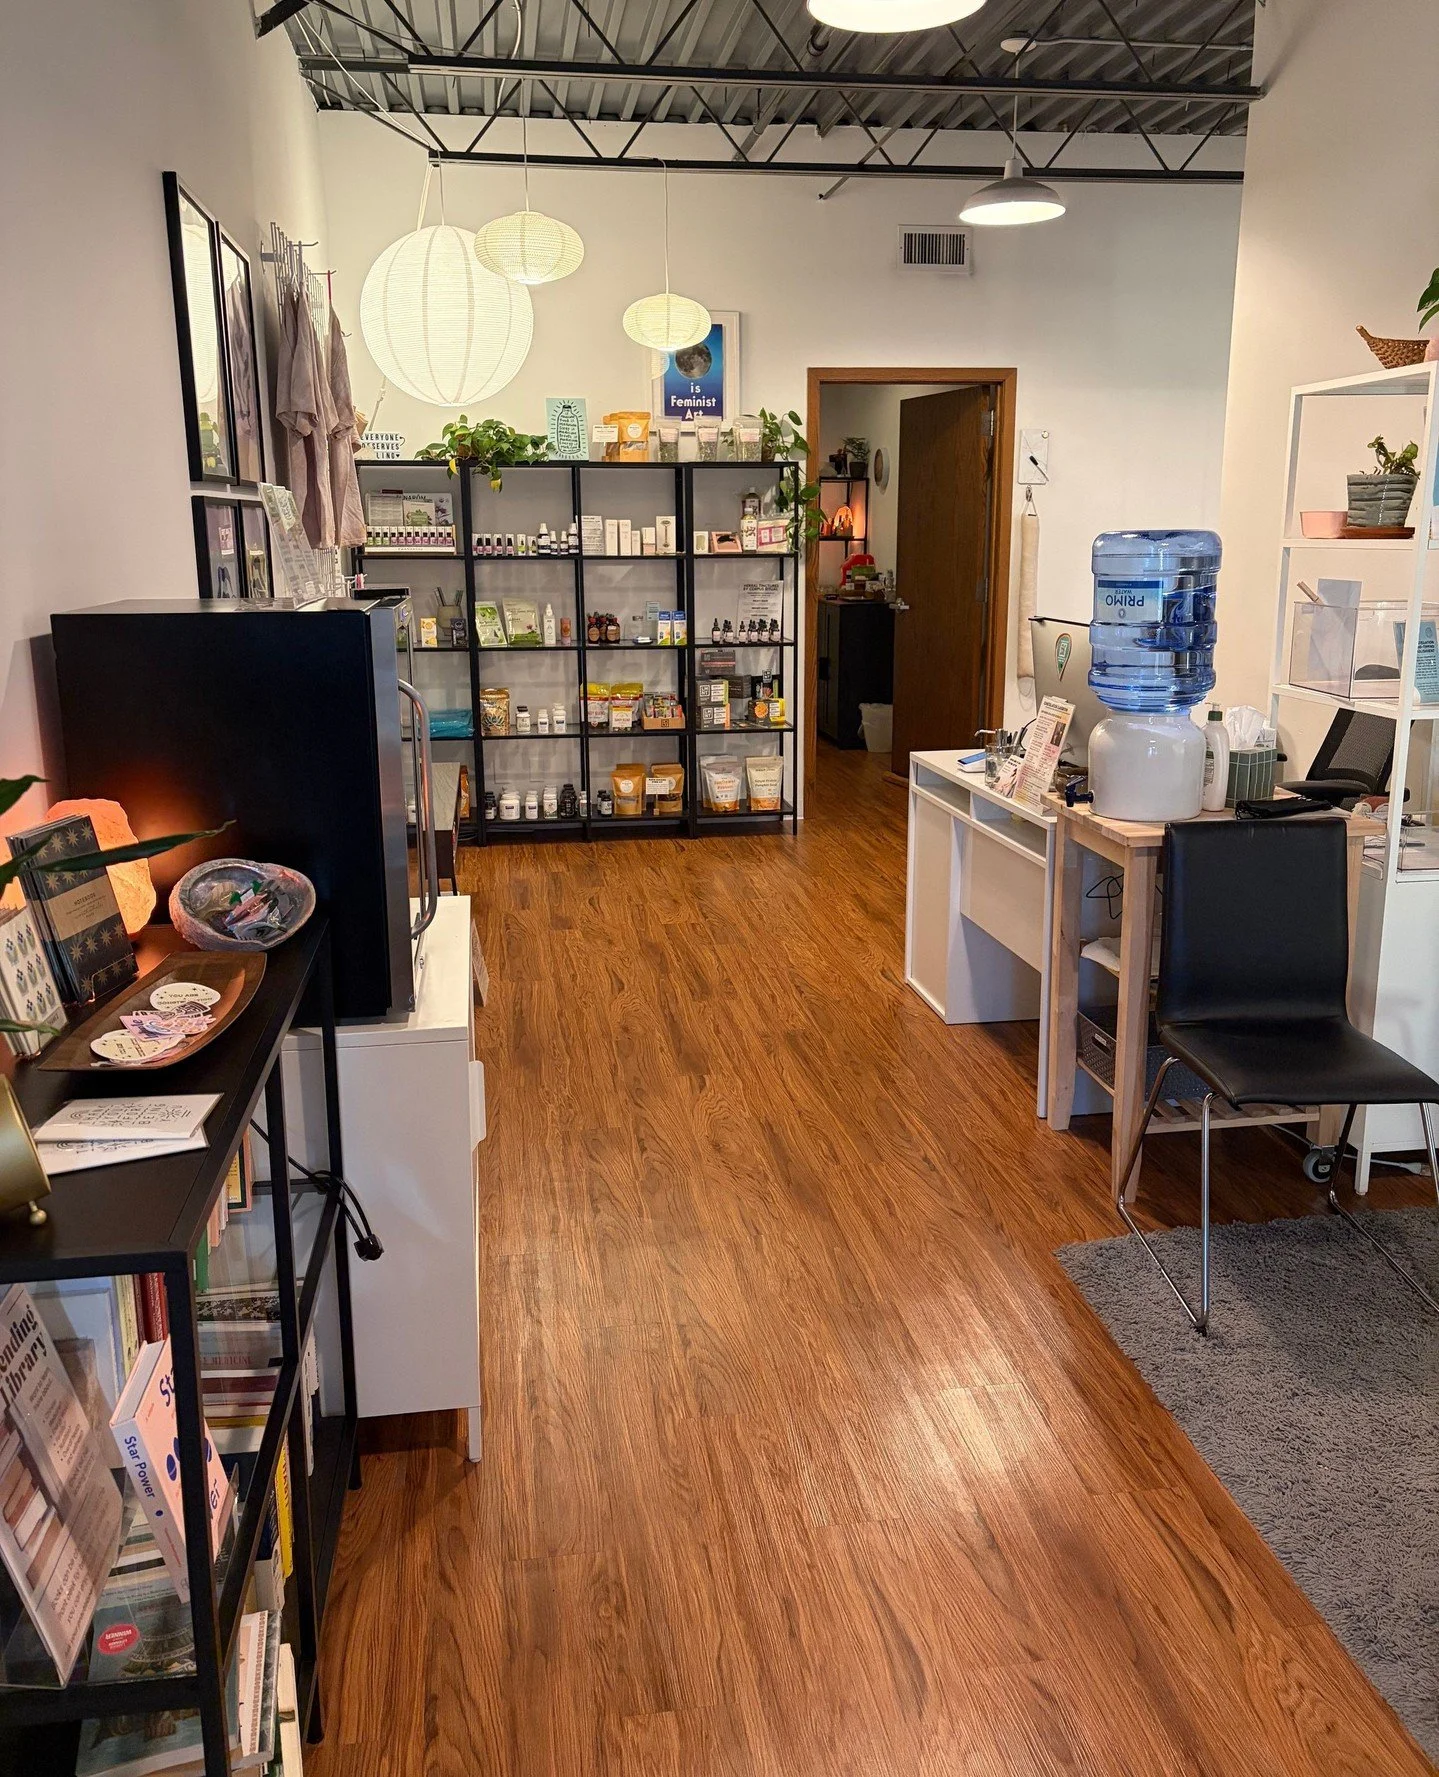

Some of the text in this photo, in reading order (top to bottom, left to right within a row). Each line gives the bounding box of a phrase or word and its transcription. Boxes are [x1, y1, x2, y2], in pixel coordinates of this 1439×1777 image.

[690, 382, 701, 393] is
[671, 396, 716, 407] Feminist
[685, 408, 703, 420] Art
[1105, 595, 1144, 607] PRIMO
[0, 1304, 38, 1373] ending
[124, 1435, 156, 1499] Star Power
[105, 1629, 132, 1640] WINNER
